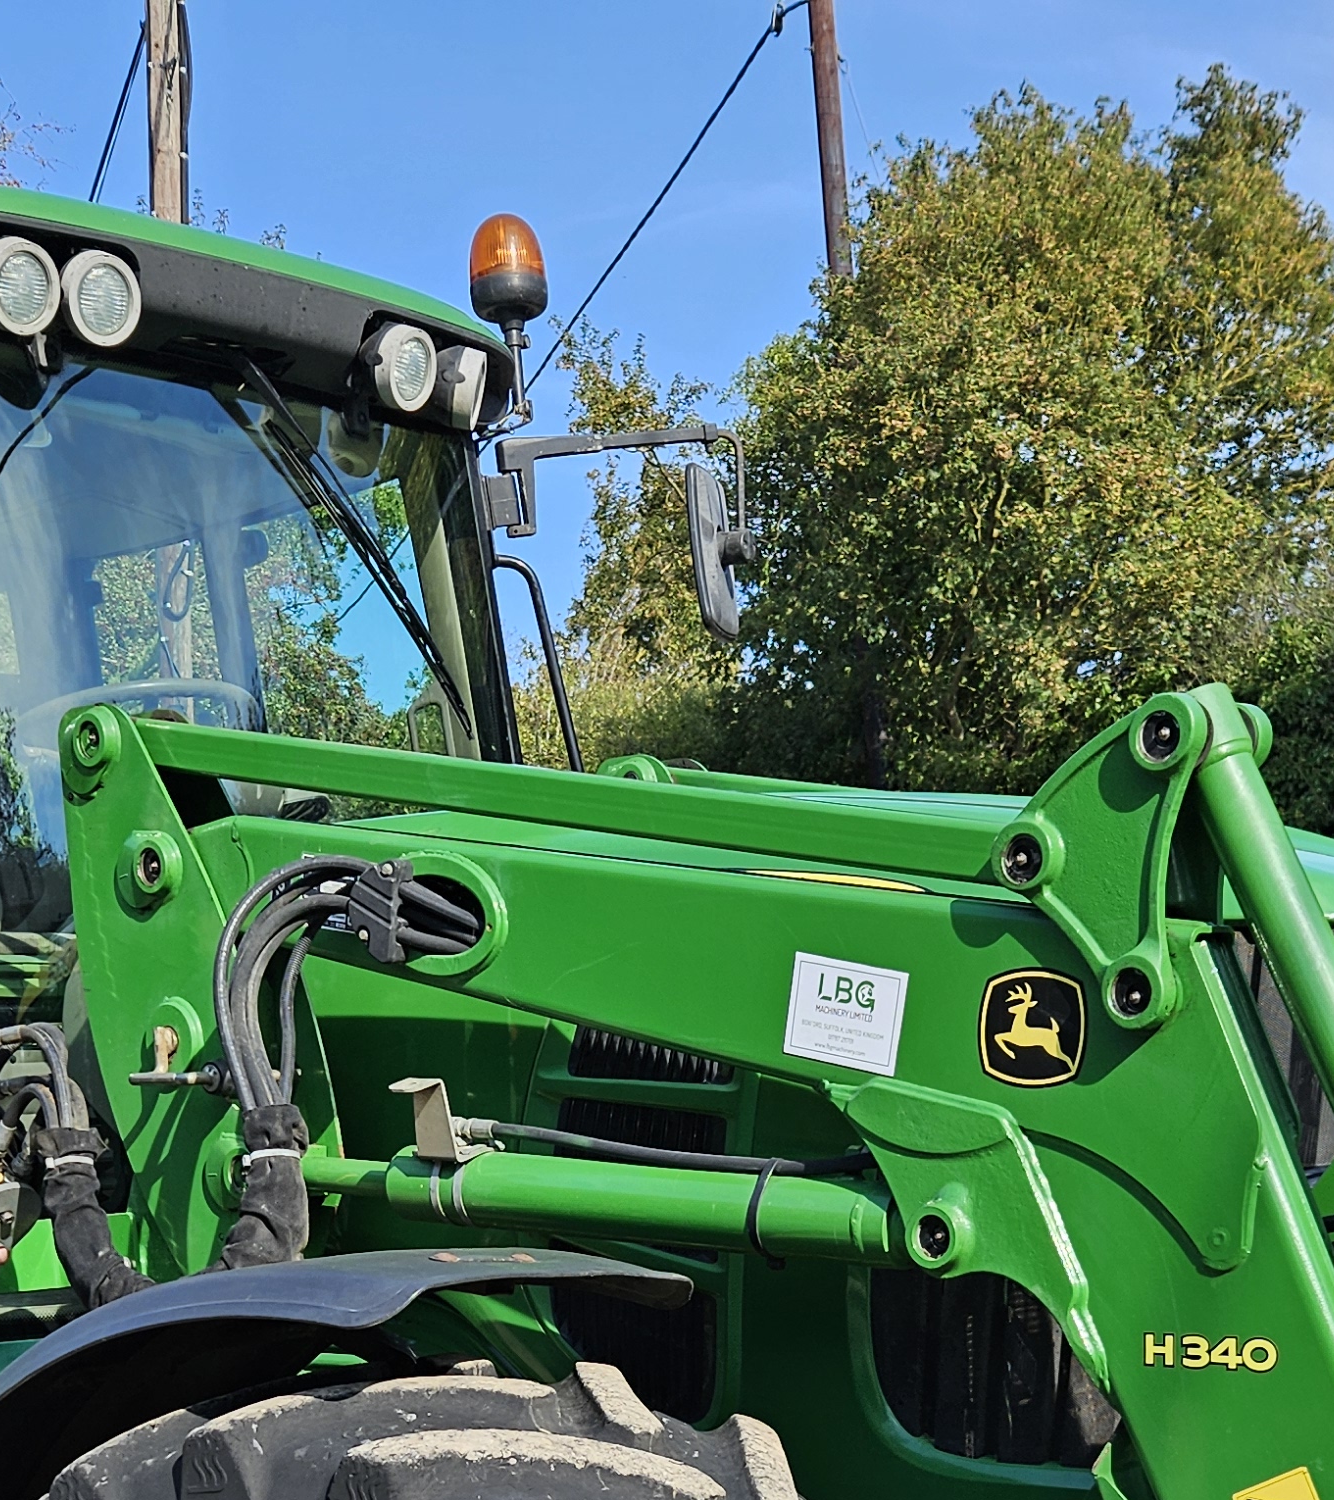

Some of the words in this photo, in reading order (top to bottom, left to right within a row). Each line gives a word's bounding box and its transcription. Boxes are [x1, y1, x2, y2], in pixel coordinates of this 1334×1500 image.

[818, 973, 875, 1013] LBG
[815, 1005, 849, 1018] MACHINERY
[849, 1011, 873, 1023] LIMITED
